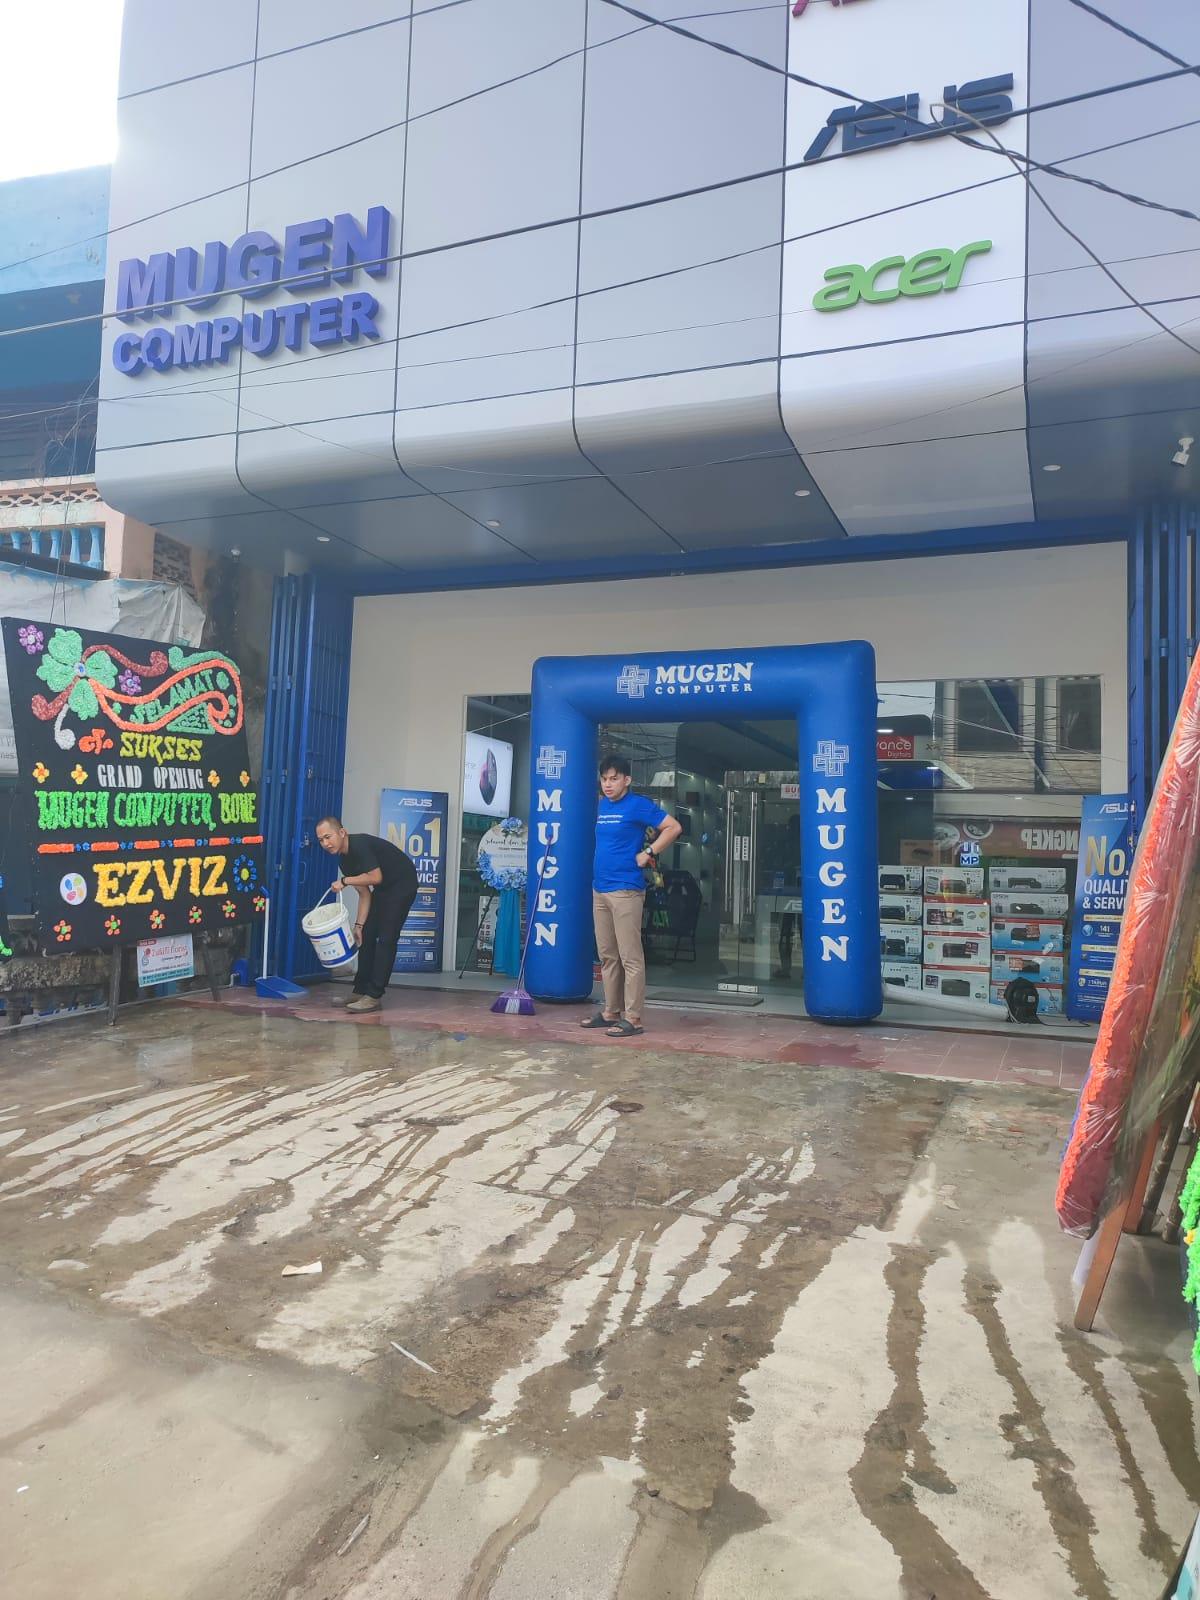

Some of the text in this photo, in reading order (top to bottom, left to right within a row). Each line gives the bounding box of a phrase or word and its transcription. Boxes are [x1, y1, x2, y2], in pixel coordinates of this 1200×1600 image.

[804, 73, 1014, 161] ASUS
[116, 206, 390, 324] MUGEN
[812, 240, 993, 312] acer
[113, 291, 380, 377] COMPUTER
[655, 662, 754, 685] MUGEN
[655, 683, 753, 695] COMPUTER
[130, 669, 214, 724] SELAMAT
[120, 732, 203, 766] SUKSES
[877, 741, 912, 750] ance
[97, 764, 204, 789] GRAND OPENING
[35, 791, 257, 832] MUGEN COMPUTER BONE
[398, 798, 433, 807] ASUS
[387, 818, 441, 857] No.1
[1085, 835, 1128, 876] No.
[93, 855, 228, 907] EZVIZ
[413, 858, 440, 871] LITY
[416, 873, 439, 883] VICE
[535, 789, 562, 947] MUGEN
[816, 788, 849, 962] MUGEN
[1082, 896, 1091, 909] &
